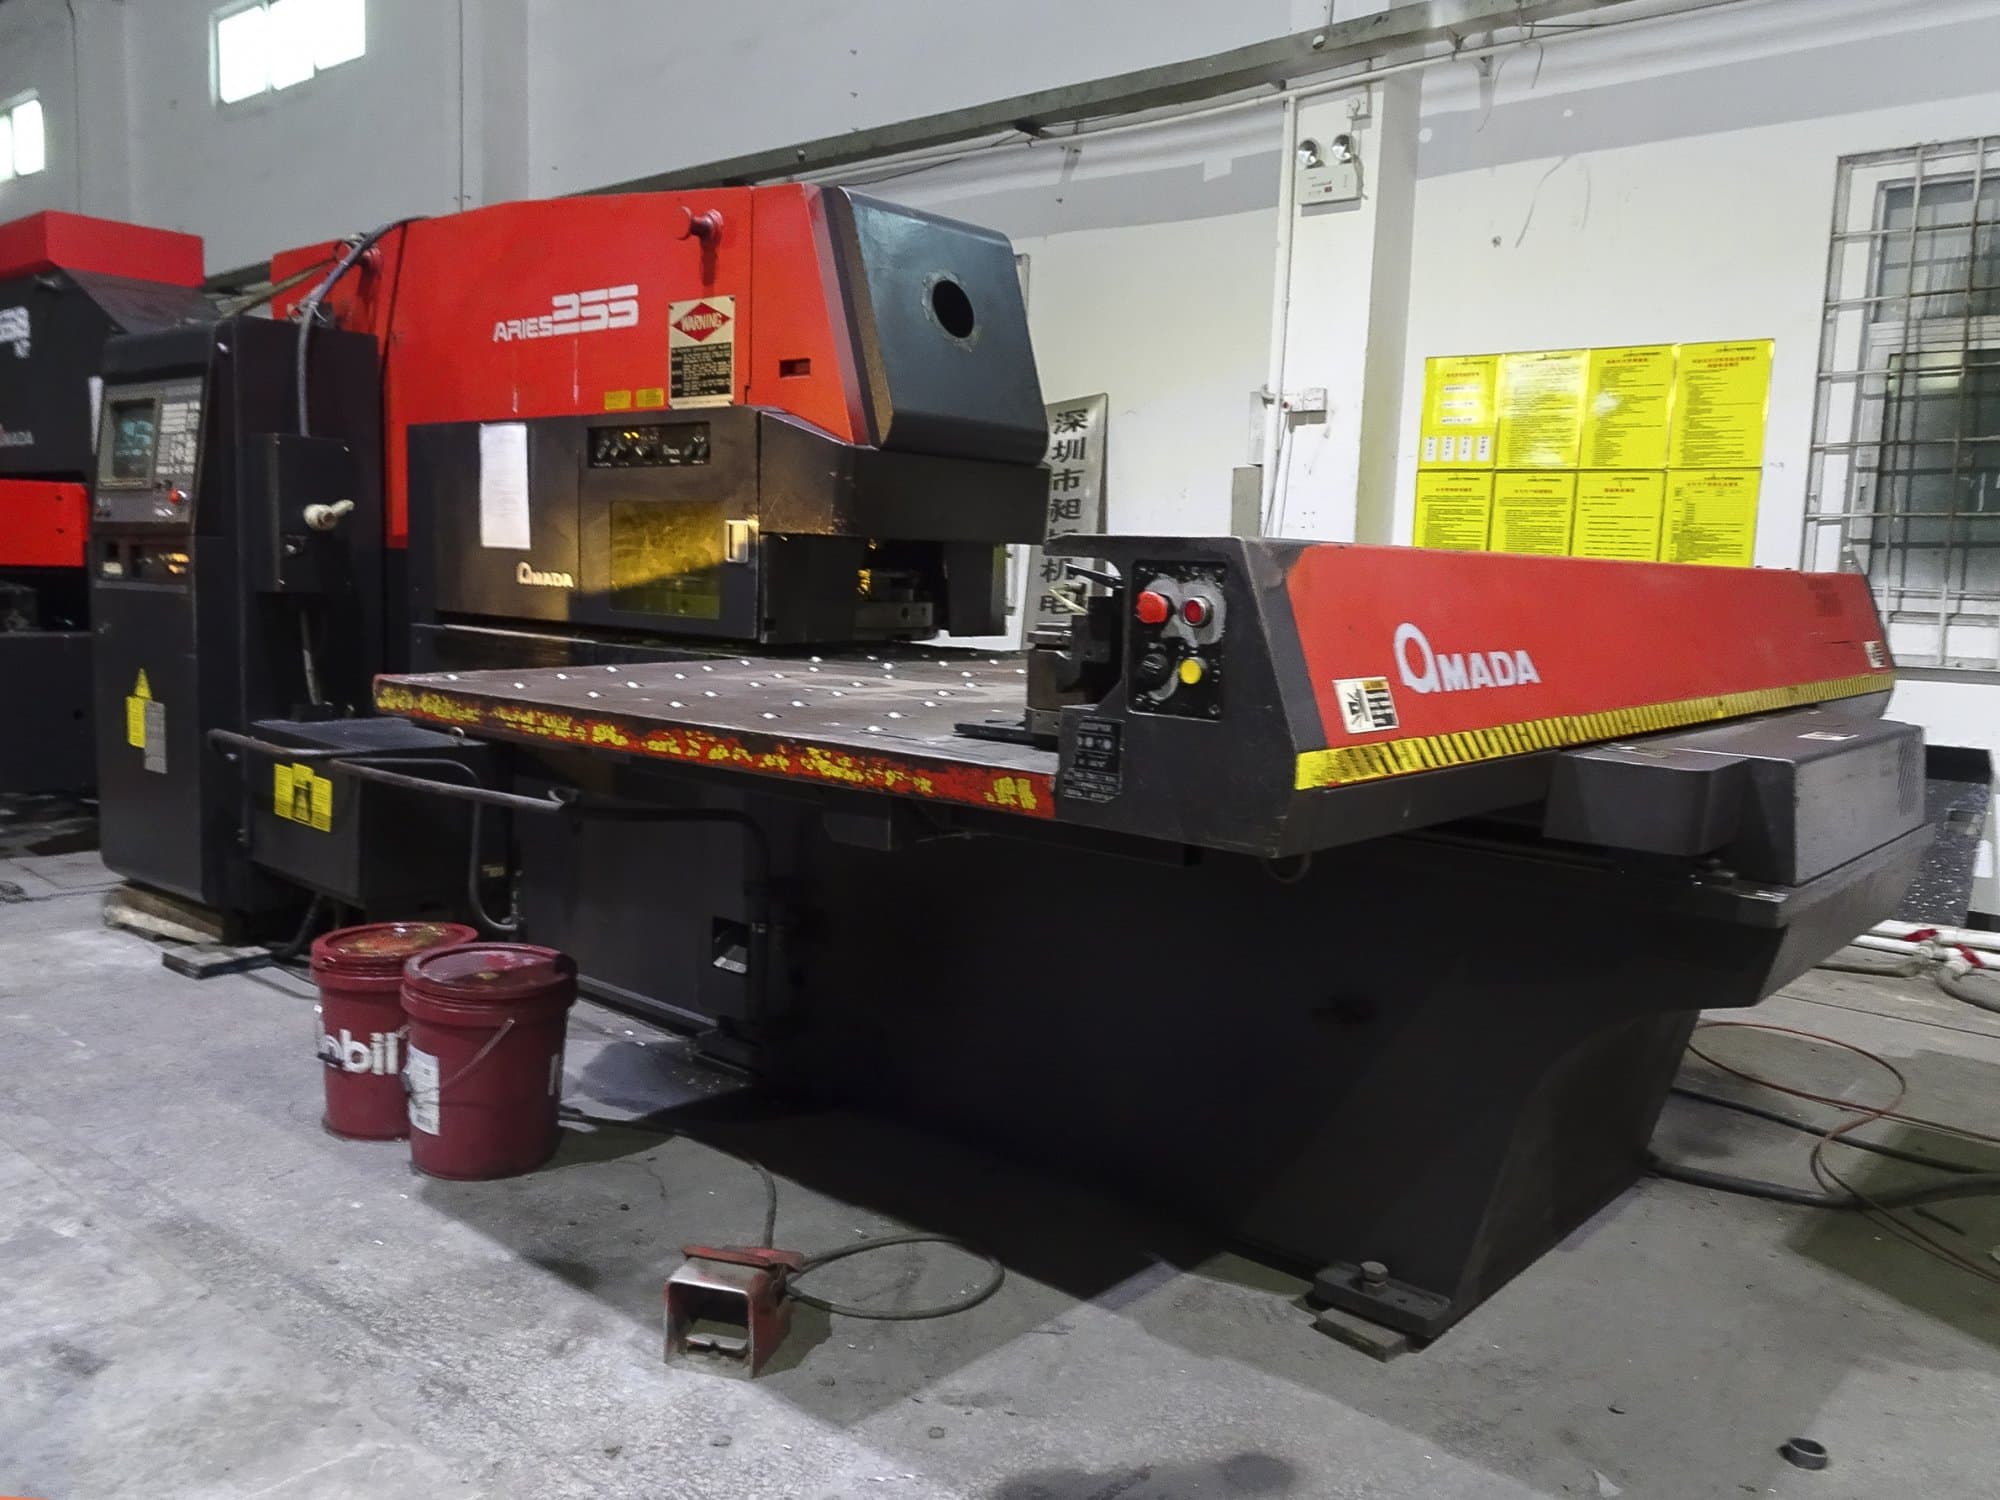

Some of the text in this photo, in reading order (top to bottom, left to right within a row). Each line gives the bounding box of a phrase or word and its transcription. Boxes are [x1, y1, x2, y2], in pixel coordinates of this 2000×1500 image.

[493, 314, 553, 344] ARIES
[680, 313, 723, 332] WARNING
[1393, 622, 1542, 694] AMADA
[319, 1028, 399, 1076] obil
